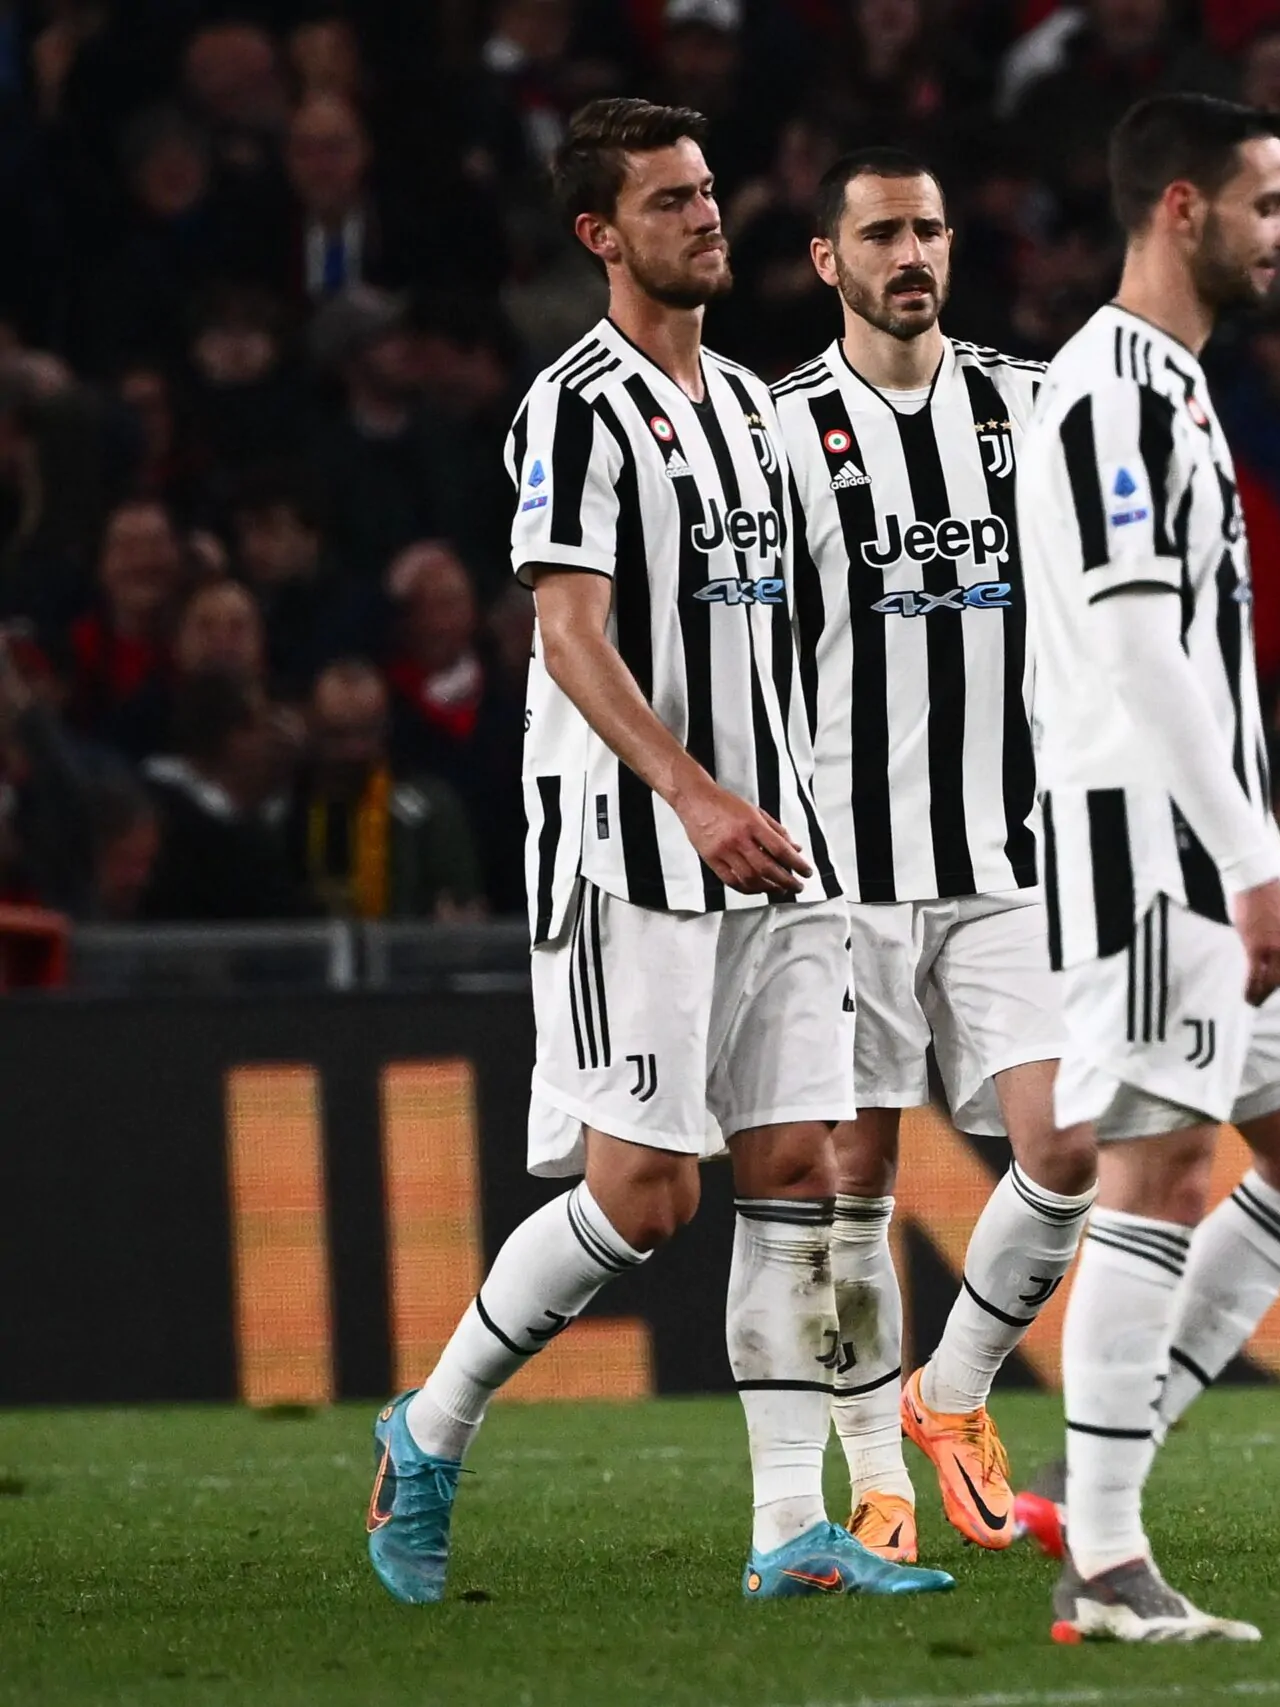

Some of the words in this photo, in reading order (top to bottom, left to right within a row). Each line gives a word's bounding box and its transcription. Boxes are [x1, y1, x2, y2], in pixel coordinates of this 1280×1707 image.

[830, 474, 873, 490] adidas
[691, 497, 782, 560] Jep
[861, 513, 1009, 569] Jeep
[225, 1056, 655, 1405] IL
